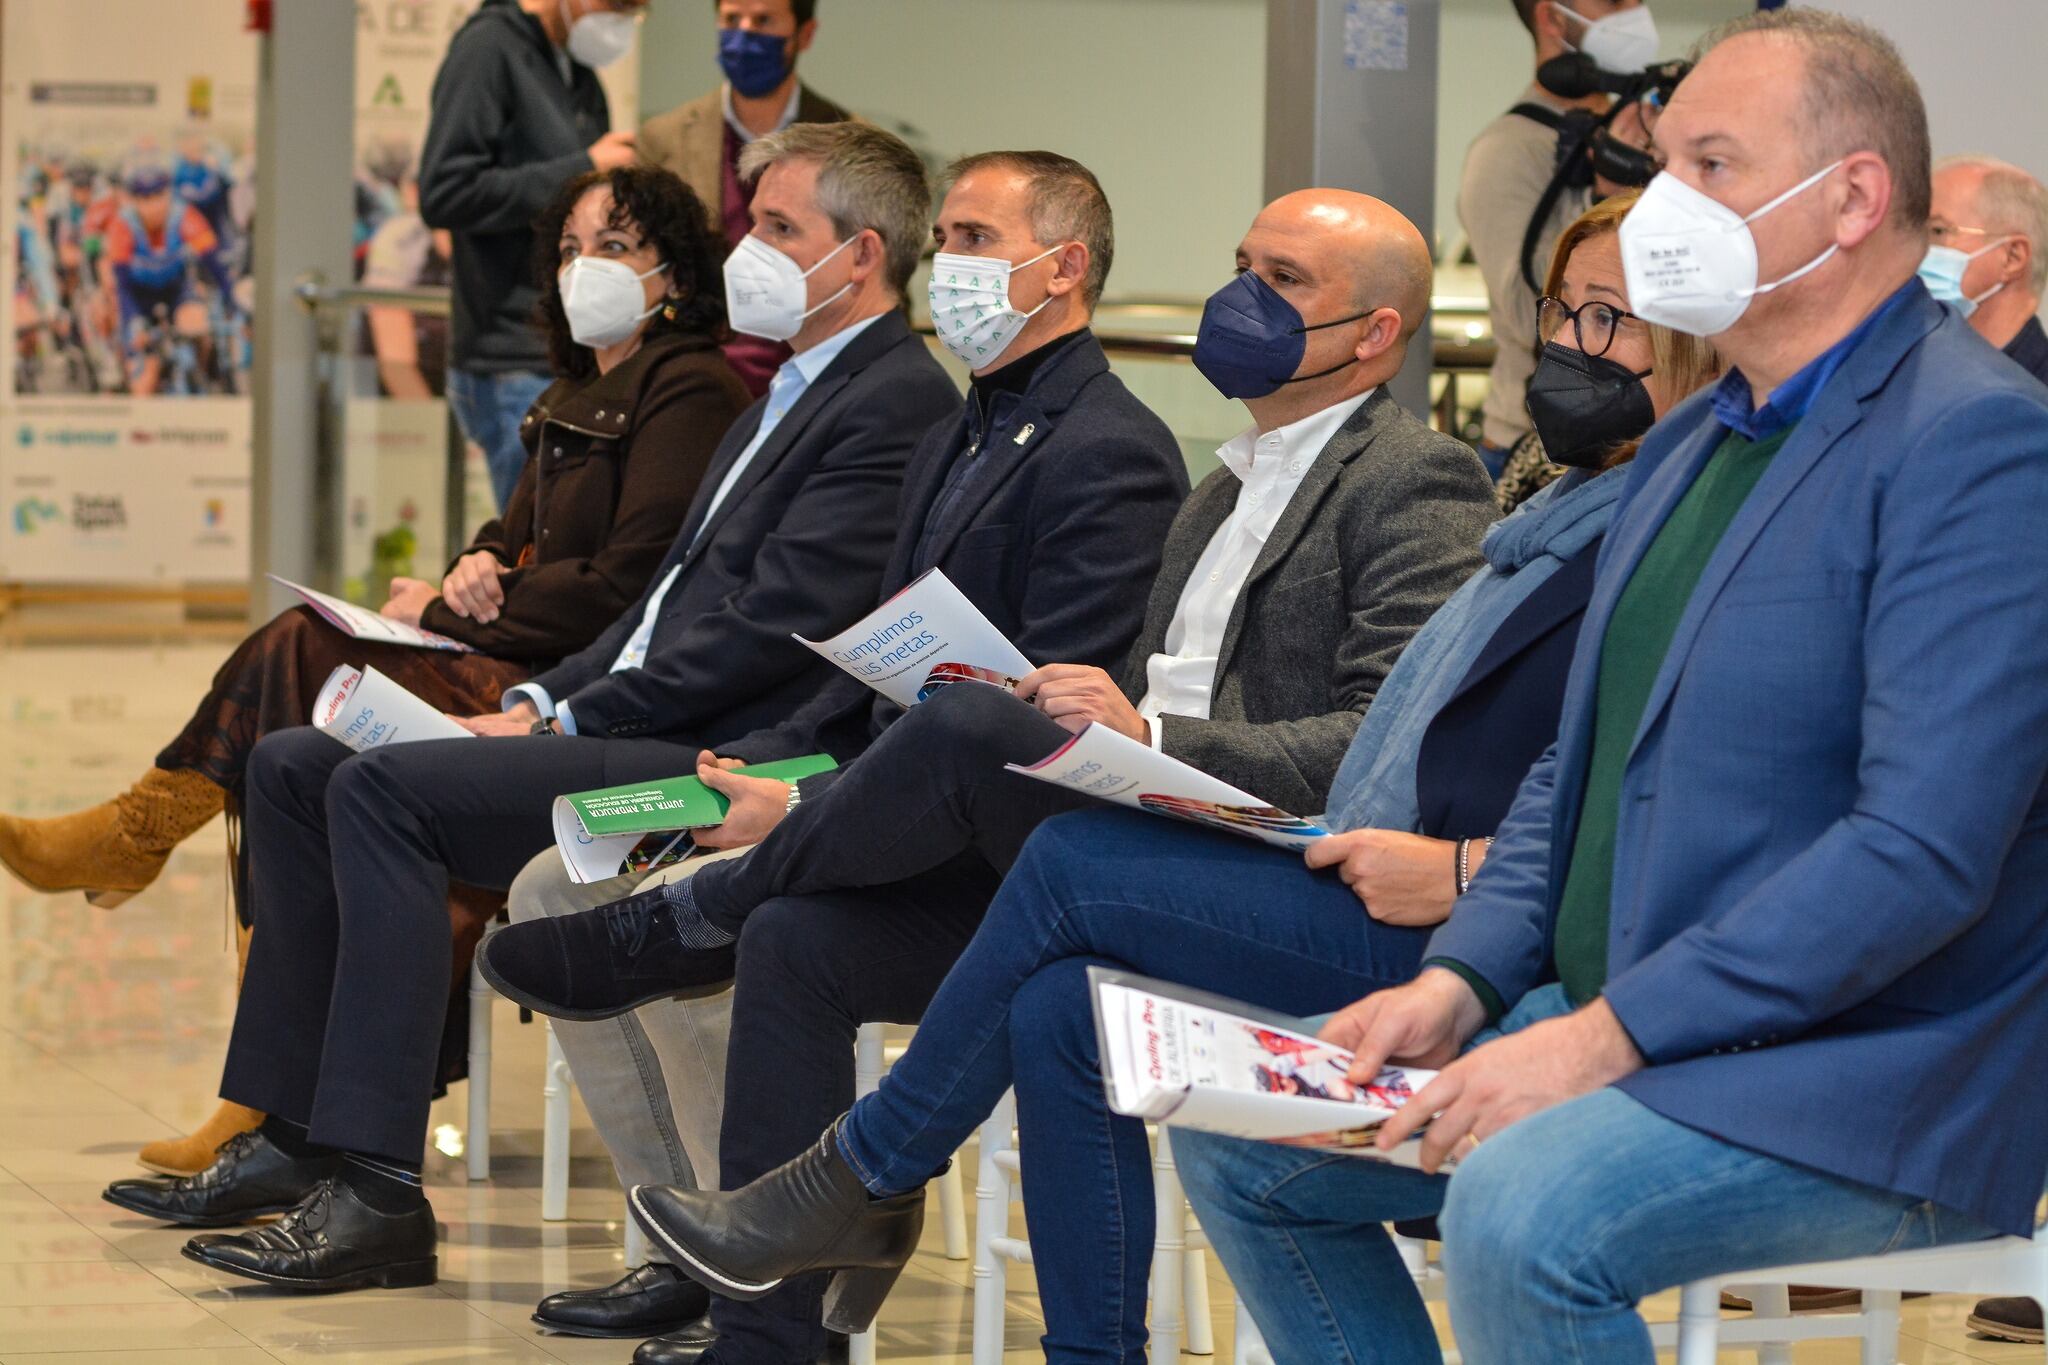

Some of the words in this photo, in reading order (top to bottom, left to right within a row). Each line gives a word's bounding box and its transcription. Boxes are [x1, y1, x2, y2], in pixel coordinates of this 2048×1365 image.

[833, 610, 923, 663] Cumplimos
[853, 662, 882, 676] tus
[880, 630, 938, 668] metas.
[324, 691, 346, 725] Cycling
[342, 673, 359, 689] Pro
[640, 803, 655, 812] DE
[656, 799, 685, 810] JUNTA
[1141, 998, 1154, 1027] Pro
